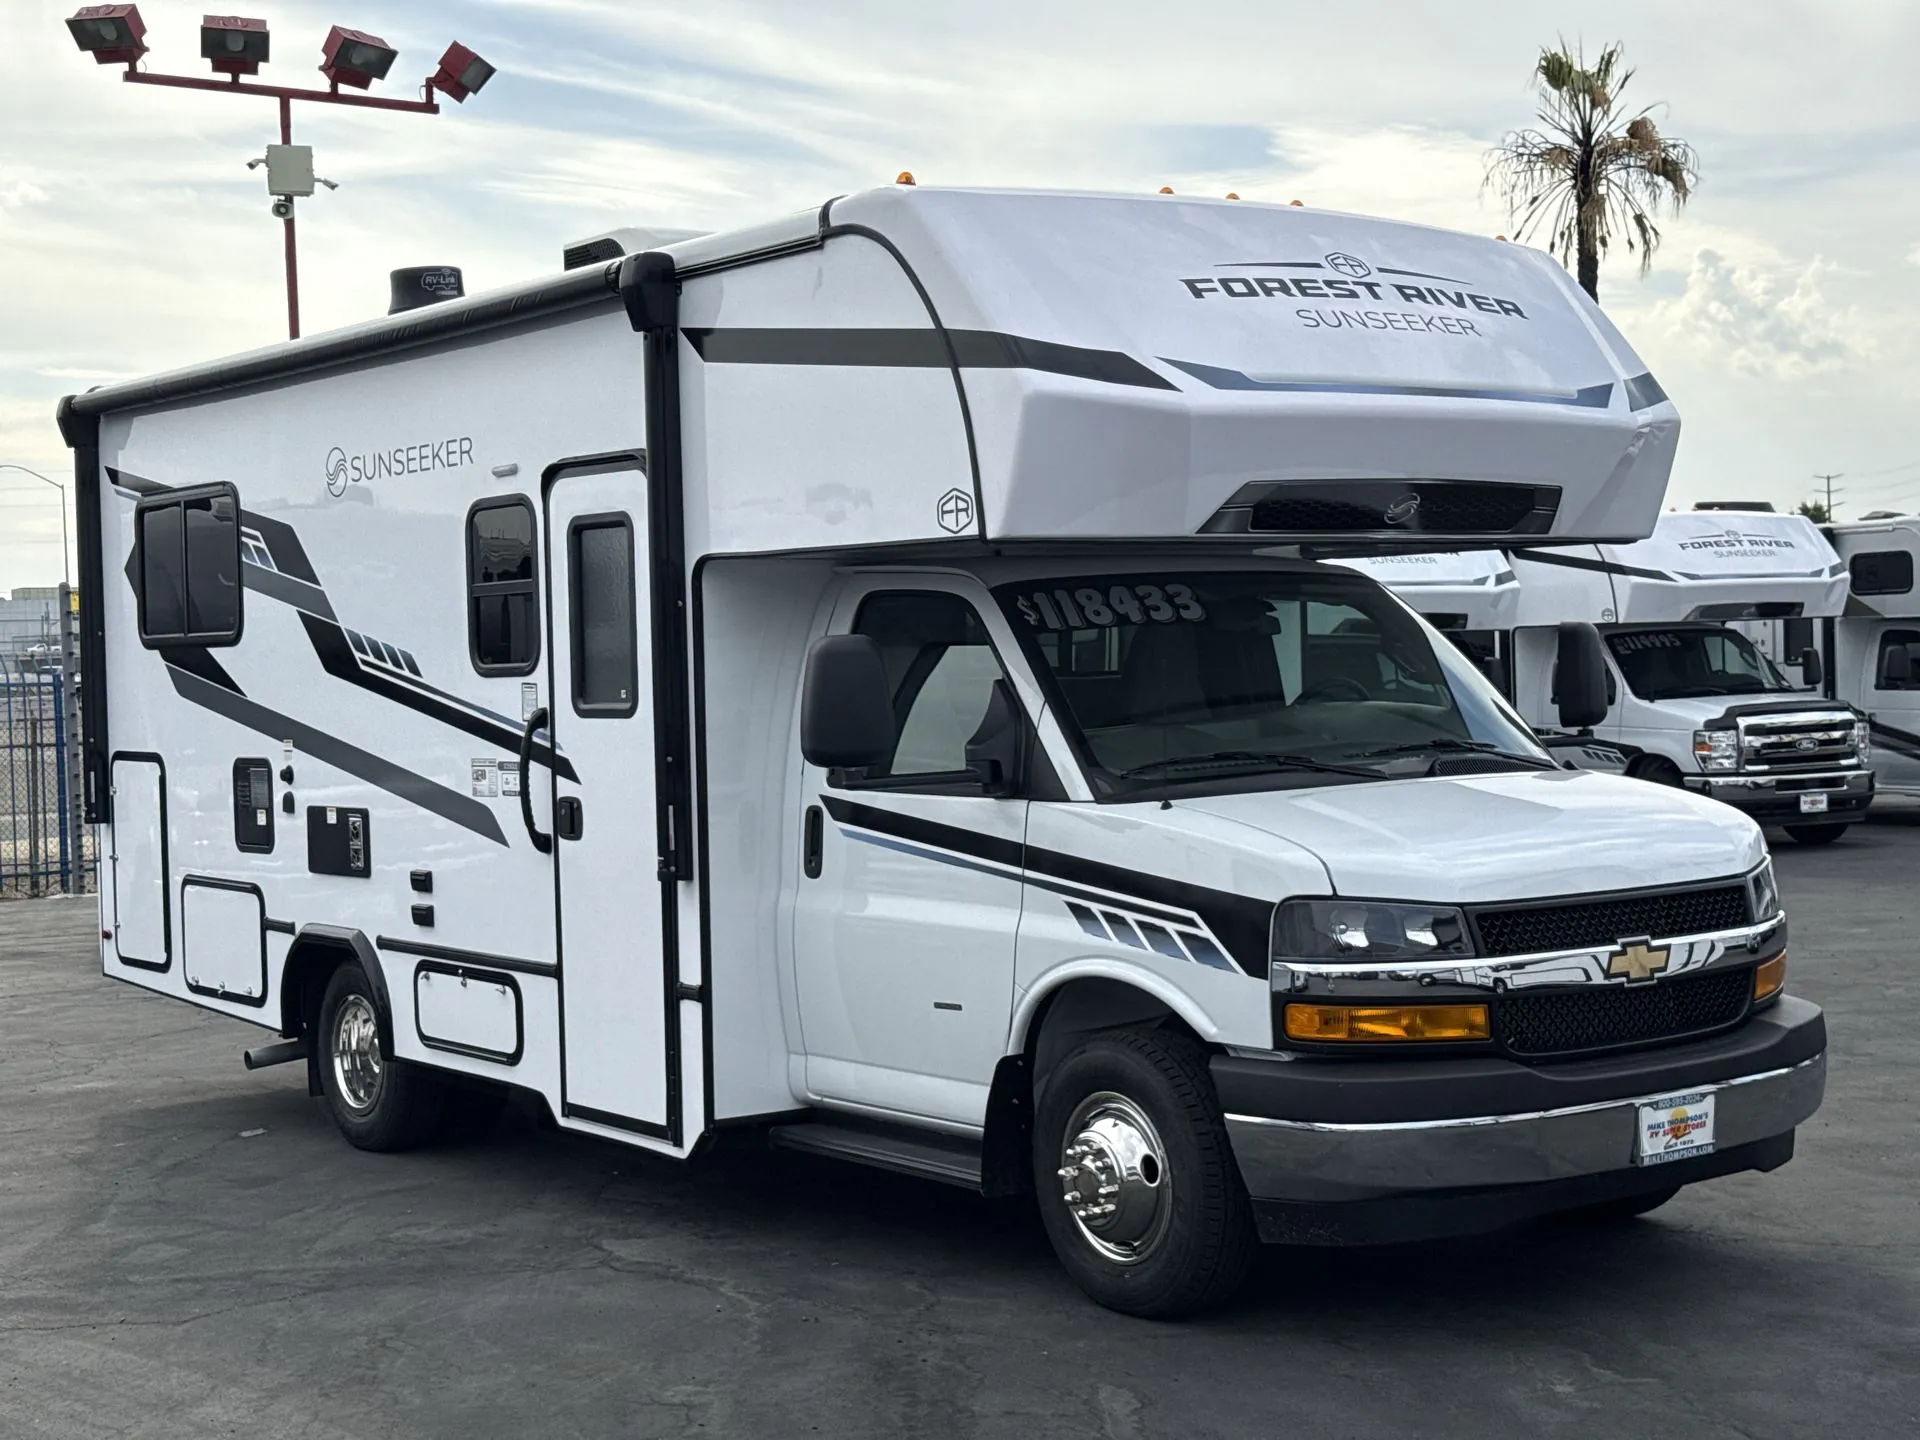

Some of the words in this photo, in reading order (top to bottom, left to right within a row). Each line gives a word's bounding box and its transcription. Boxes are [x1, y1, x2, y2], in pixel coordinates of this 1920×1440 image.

[425, 275, 456, 284] RV-Link
[1178, 277, 1382, 300] FOREST
[1389, 283, 1530, 320] RIVER
[1295, 308, 1482, 337] SUNSEEKER
[350, 436, 474, 482] SUNSEEKER
[1678, 539, 1746, 550] FOREST
[1749, 539, 1796, 549] RIVER
[1713, 550, 1777, 558] SUNSEEKER
[1368, 555, 1438, 565] SUNSEEKER
[1017, 583, 1206, 630] $118433
[1647, 1121, 1665, 1131] MIKE
